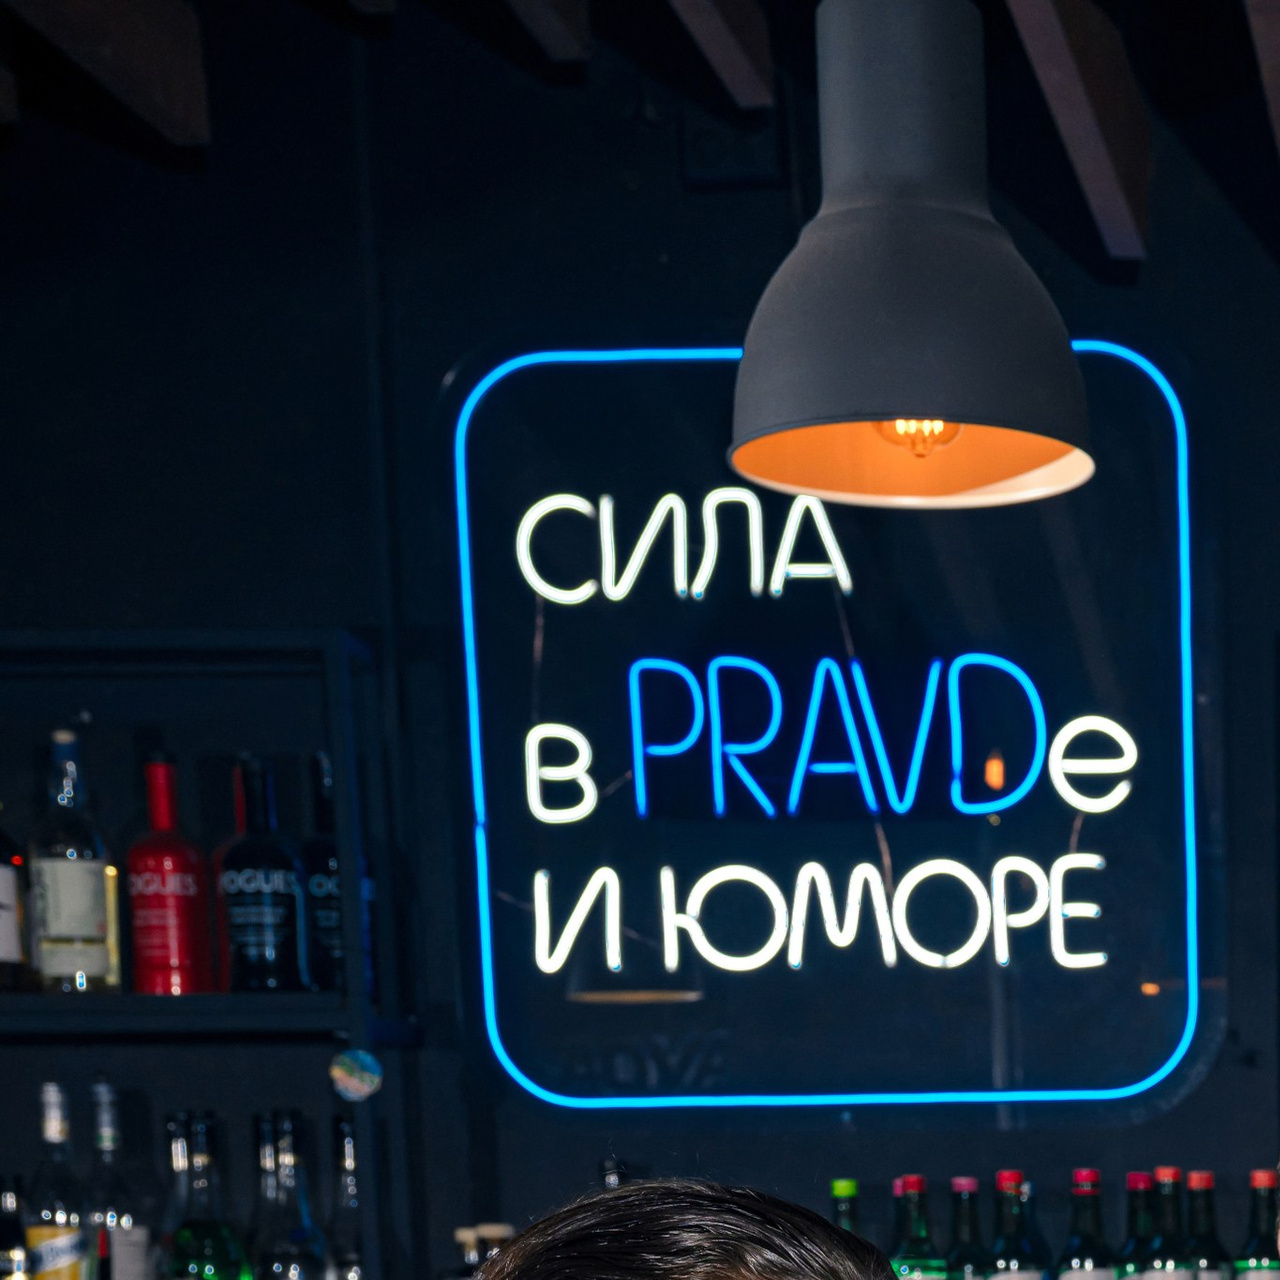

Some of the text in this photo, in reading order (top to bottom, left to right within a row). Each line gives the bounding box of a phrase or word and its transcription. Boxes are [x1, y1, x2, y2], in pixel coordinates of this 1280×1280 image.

[515, 487, 853, 605] СИЛА
[533, 852, 1108, 974] И ЮМОРЕ
